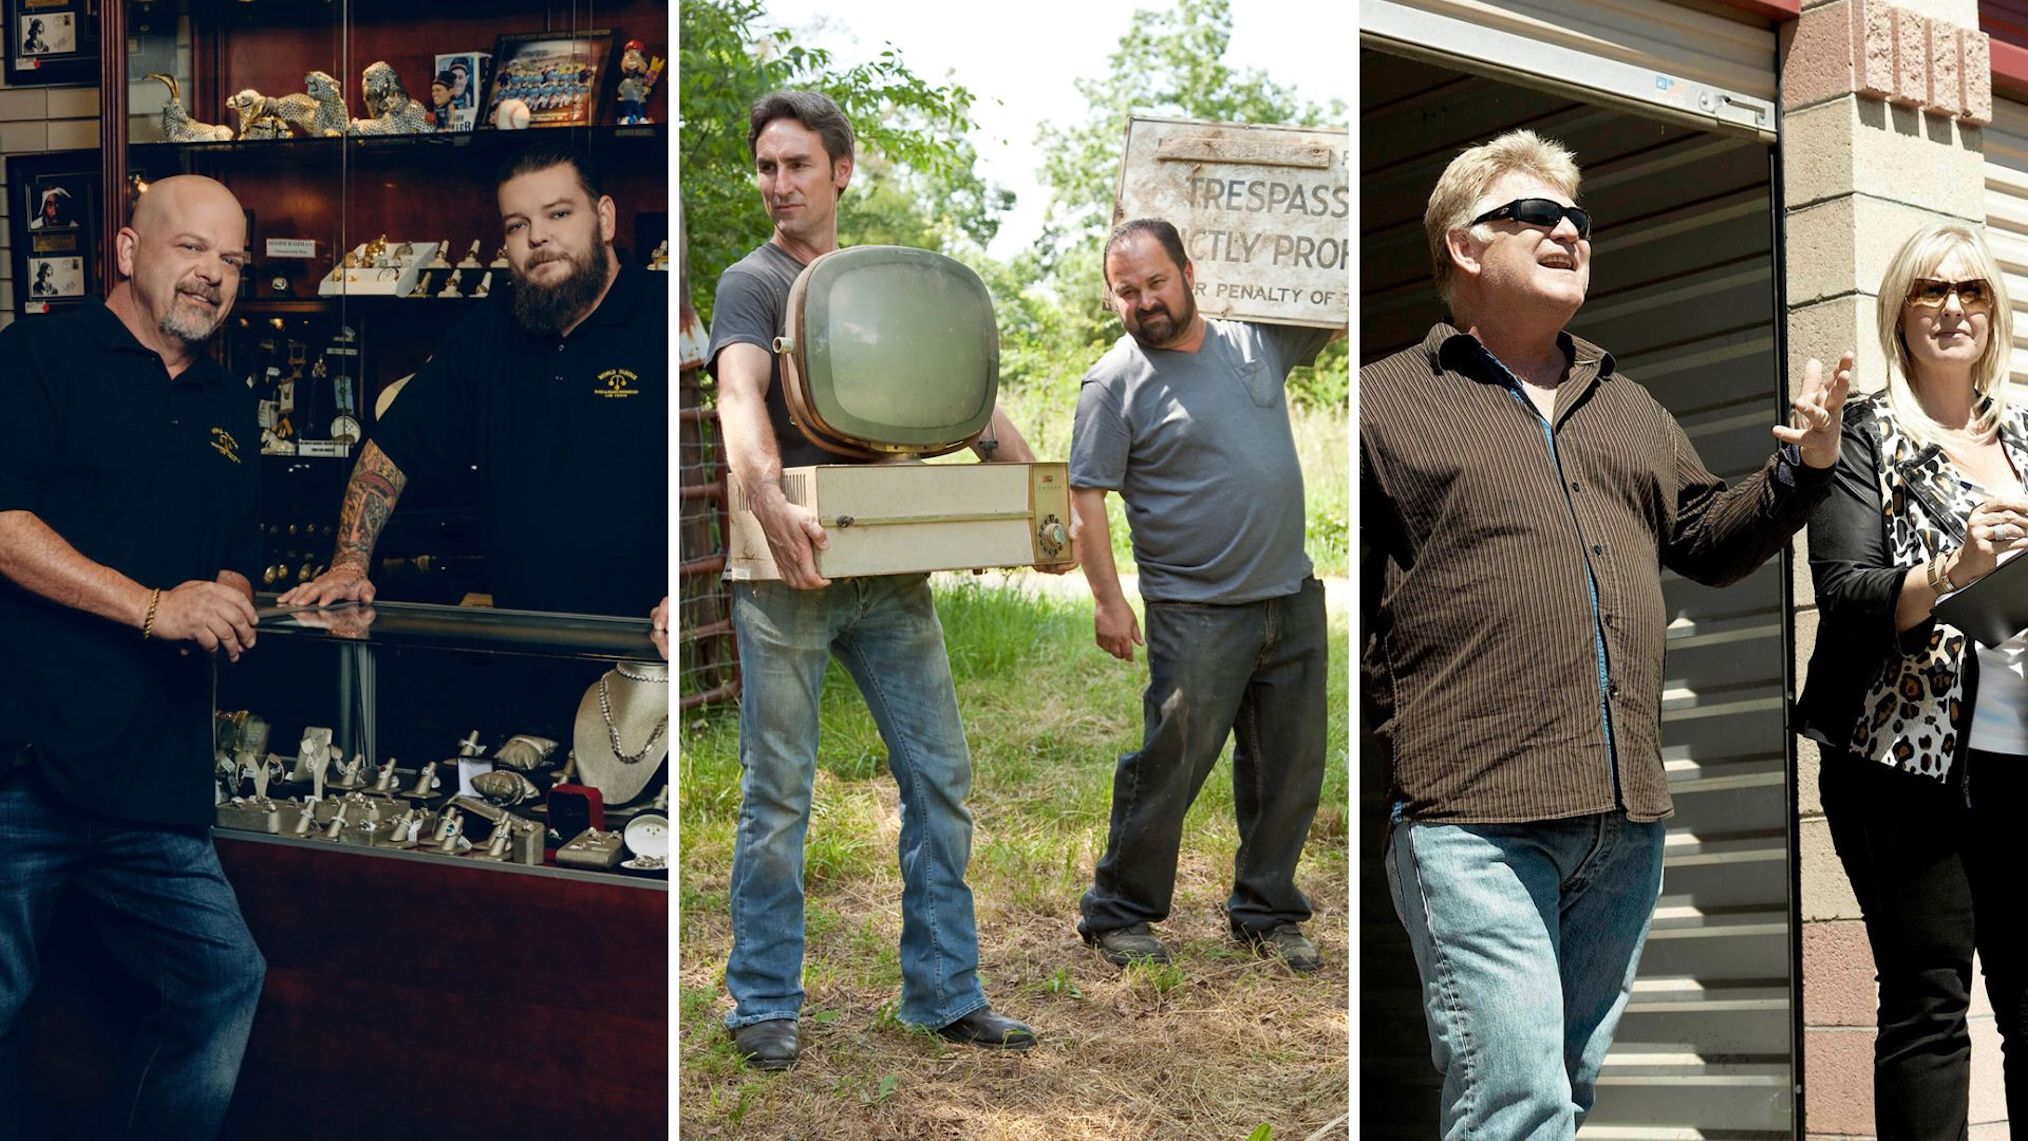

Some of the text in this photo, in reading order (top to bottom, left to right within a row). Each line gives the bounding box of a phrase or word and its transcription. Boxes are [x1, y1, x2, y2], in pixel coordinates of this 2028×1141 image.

[1185, 176, 1349, 219] TRESPASS
[1216, 283, 1303, 303] PENALTY
[1310, 290, 1335, 306] OF
